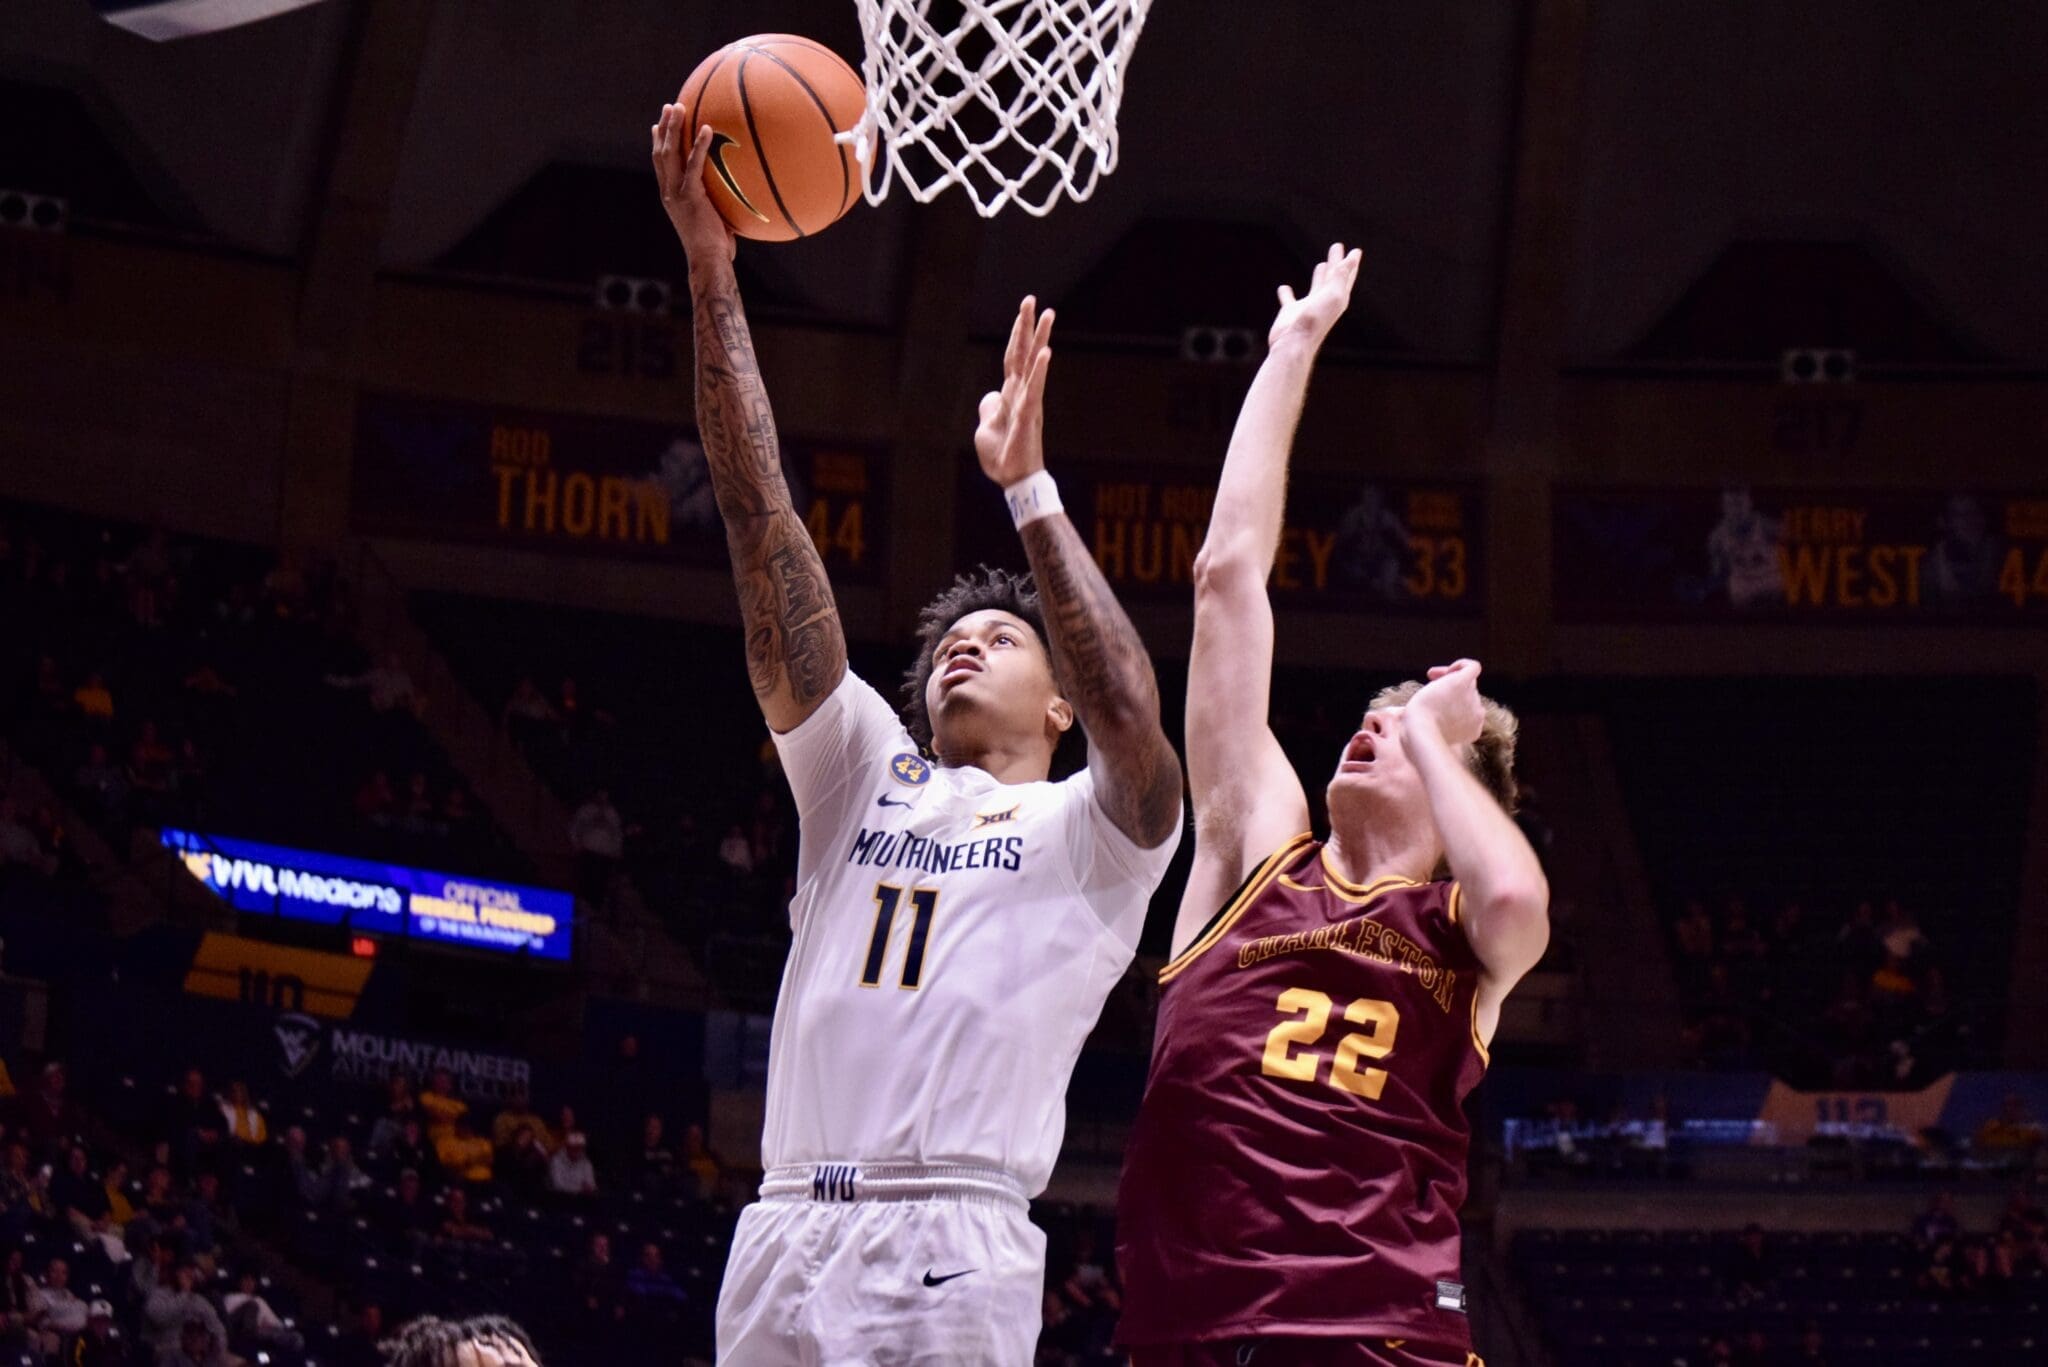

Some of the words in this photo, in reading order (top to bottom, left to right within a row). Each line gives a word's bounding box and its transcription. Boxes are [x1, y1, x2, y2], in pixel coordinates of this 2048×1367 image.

[576, 316, 673, 377] 215
[490, 426, 552, 466] ROD
[491, 465, 671, 544] THORN
[806, 496, 866, 565] 44
[1095, 518, 1338, 592] HUNEY
[1408, 535, 1466, 599] 33
[1777, 543, 1927, 608] WEST
[895, 761, 923, 782] 44
[858, 881, 941, 992] 11
[332, 1028, 531, 1083] MOUNTAINEER
[1261, 986, 1401, 1102] 22
[813, 1165, 858, 1202] WVU
